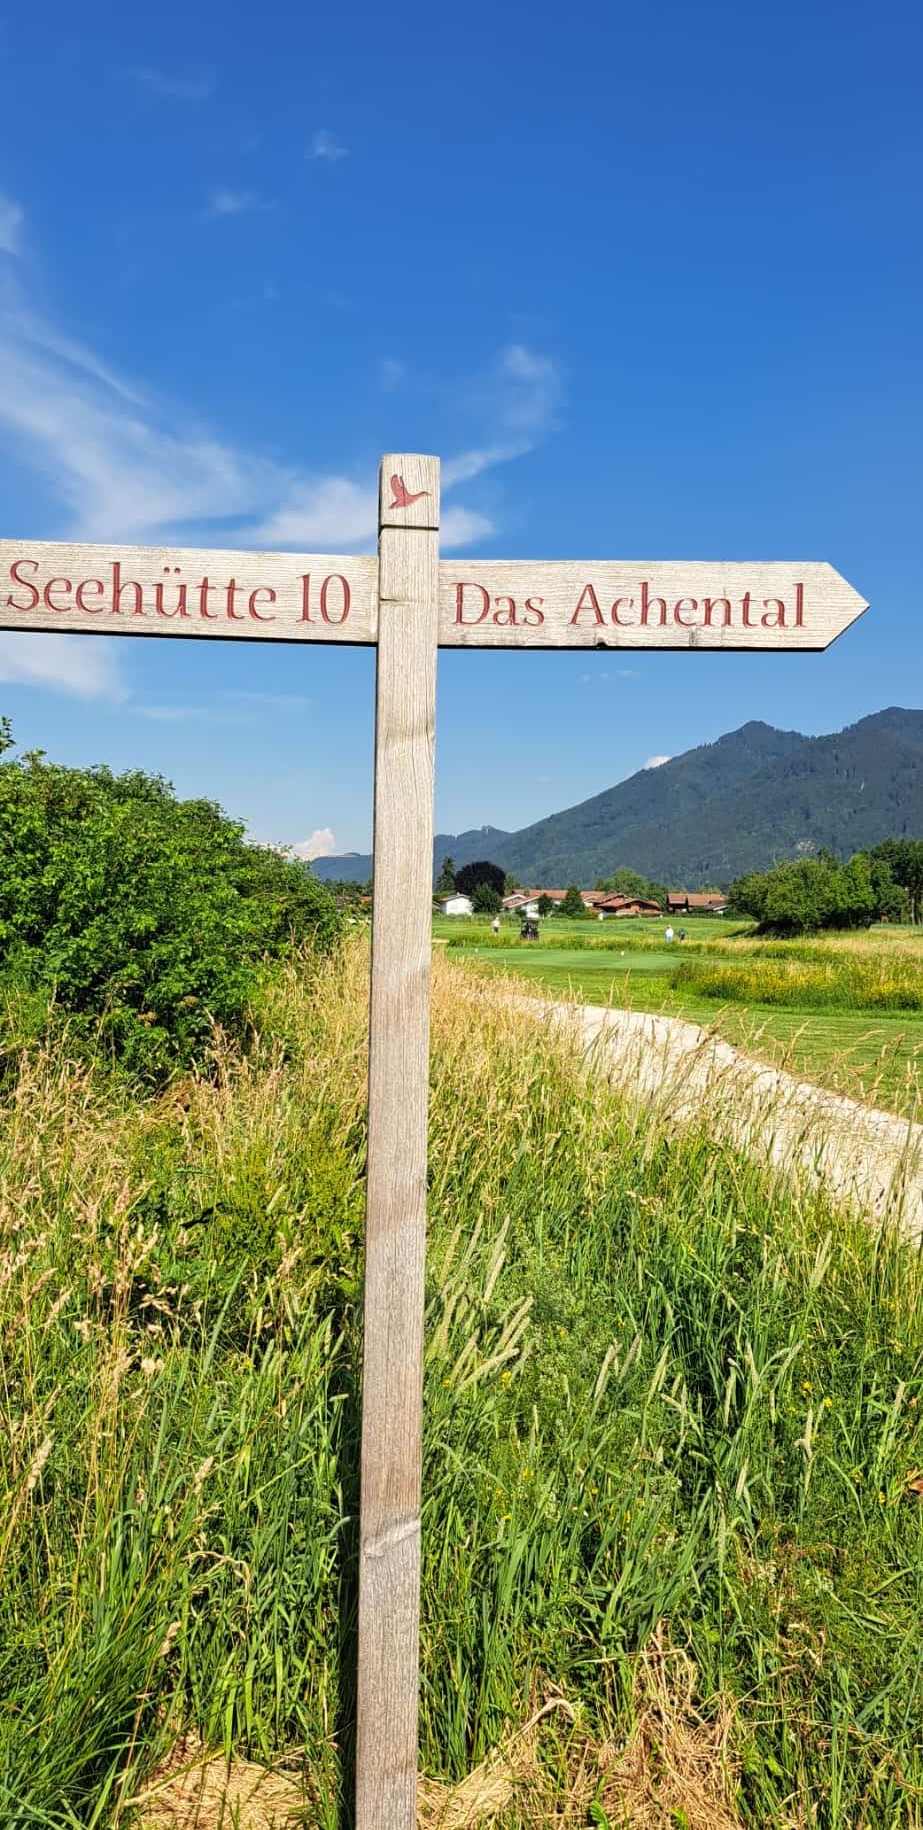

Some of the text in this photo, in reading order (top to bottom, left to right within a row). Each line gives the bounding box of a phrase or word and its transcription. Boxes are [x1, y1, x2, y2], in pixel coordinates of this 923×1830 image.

[6, 559, 352, 625] Seehütte 10
[451, 581, 808, 629] Das Achental
